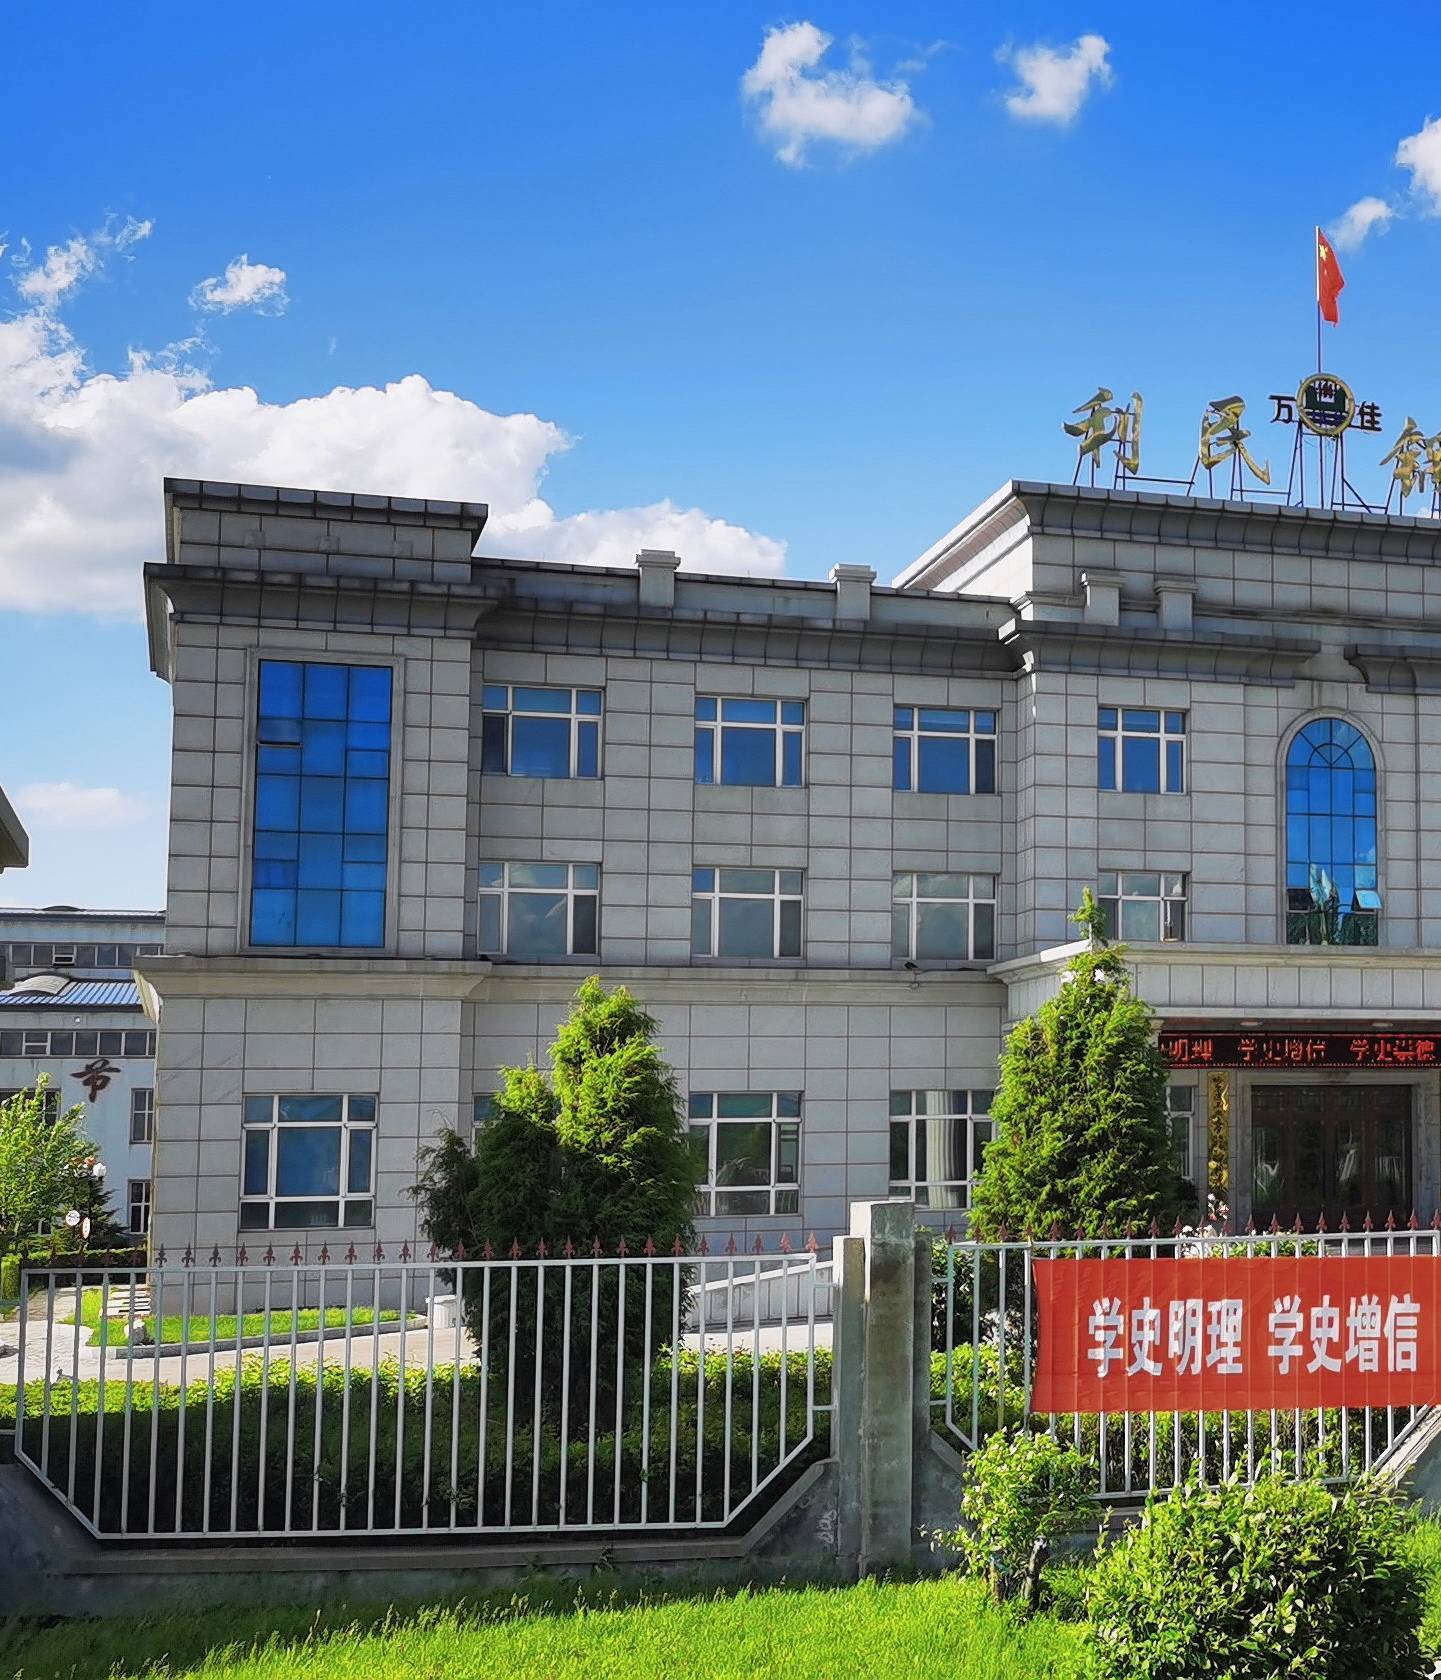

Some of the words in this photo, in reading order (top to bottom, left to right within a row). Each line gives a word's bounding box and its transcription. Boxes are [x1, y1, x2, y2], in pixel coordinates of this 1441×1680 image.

[1350, 1039, 1435, 1062] 学史崇德
[1088, 1297, 1243, 1378] 学史明理
[1268, 1294, 1420, 1374] 学史增信
